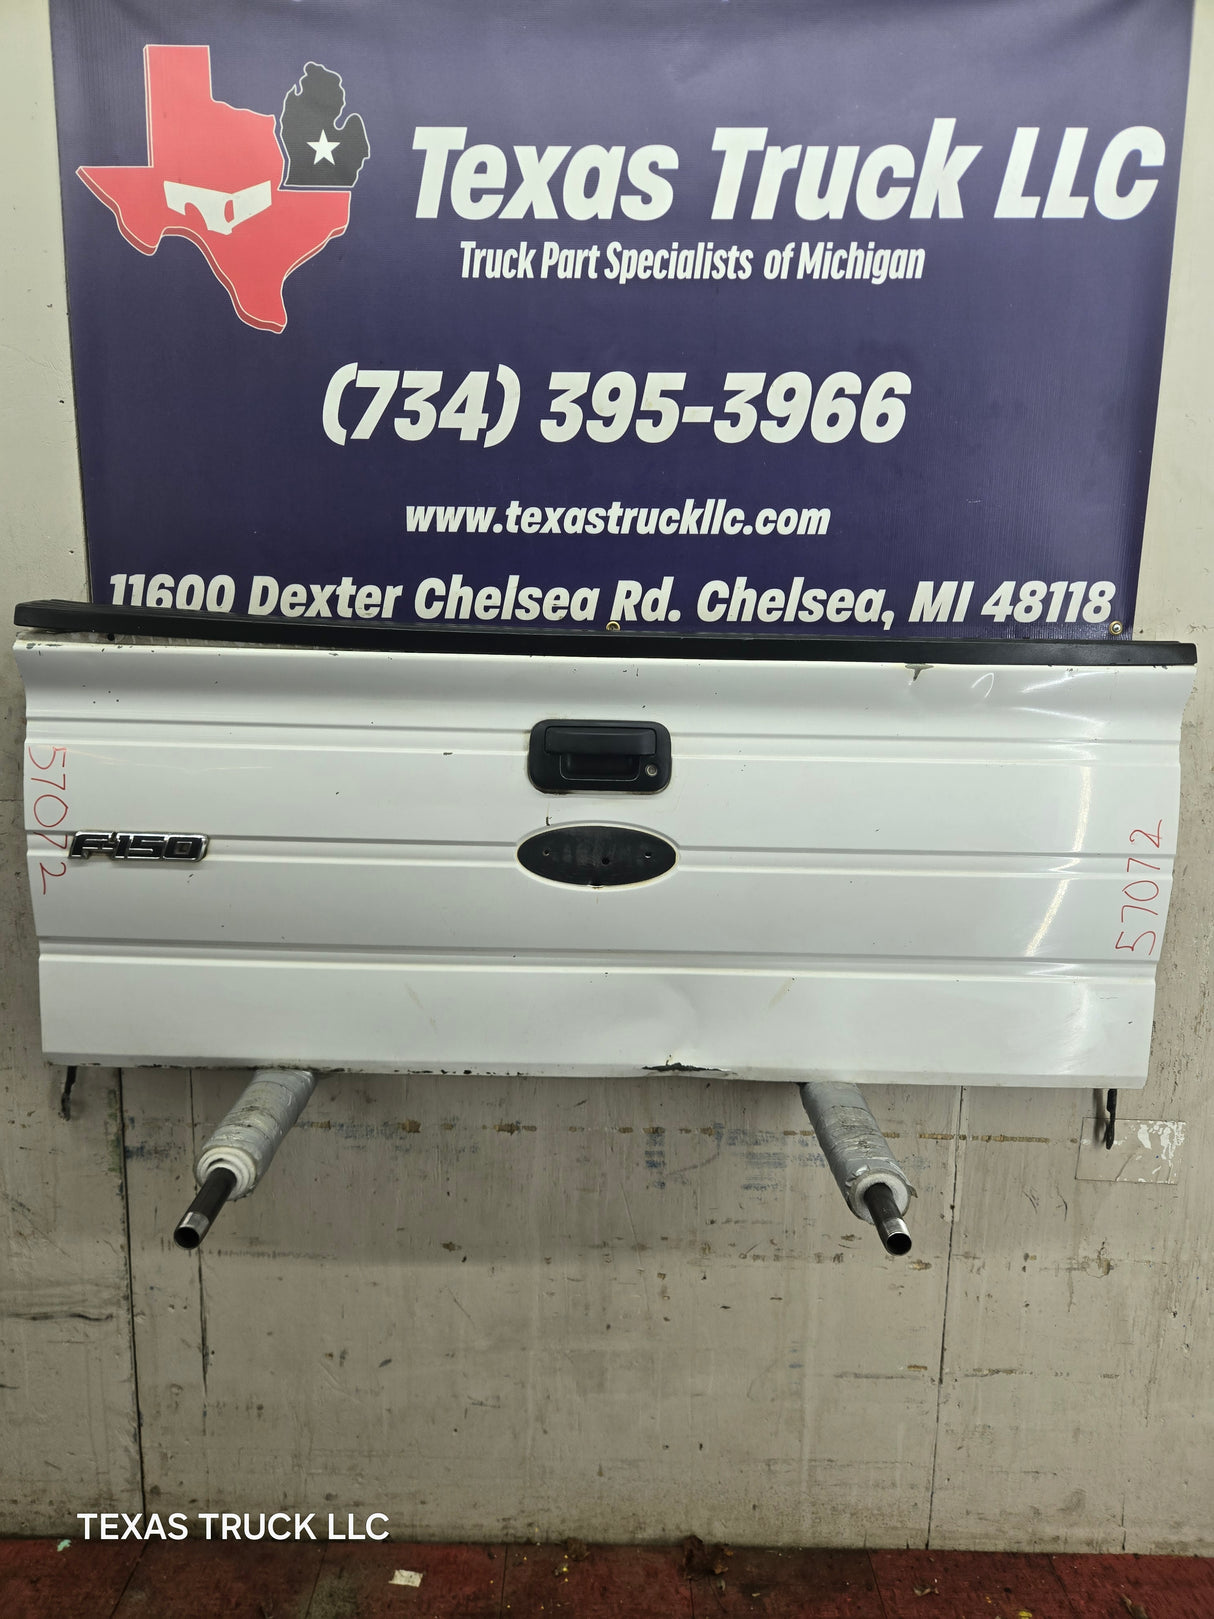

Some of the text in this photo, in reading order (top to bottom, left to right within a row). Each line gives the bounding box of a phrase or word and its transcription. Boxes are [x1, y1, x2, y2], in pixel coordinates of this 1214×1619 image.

[412, 117, 1167, 222] Texas Truck LLC
[461, 241, 926, 285] Truck Part Specialists of Michigan
[322, 362, 912, 448] (734) 395-3966
[405, 498, 832, 536] www.texastruckllc.com
[110, 573, 1117, 631] 11600 Dexter Chelsea Rd. Chelsea, MI 48118
[28, 746, 69, 895] 57072
[68, 830, 210, 863] F-150
[1114, 819, 1163, 956] 57072
